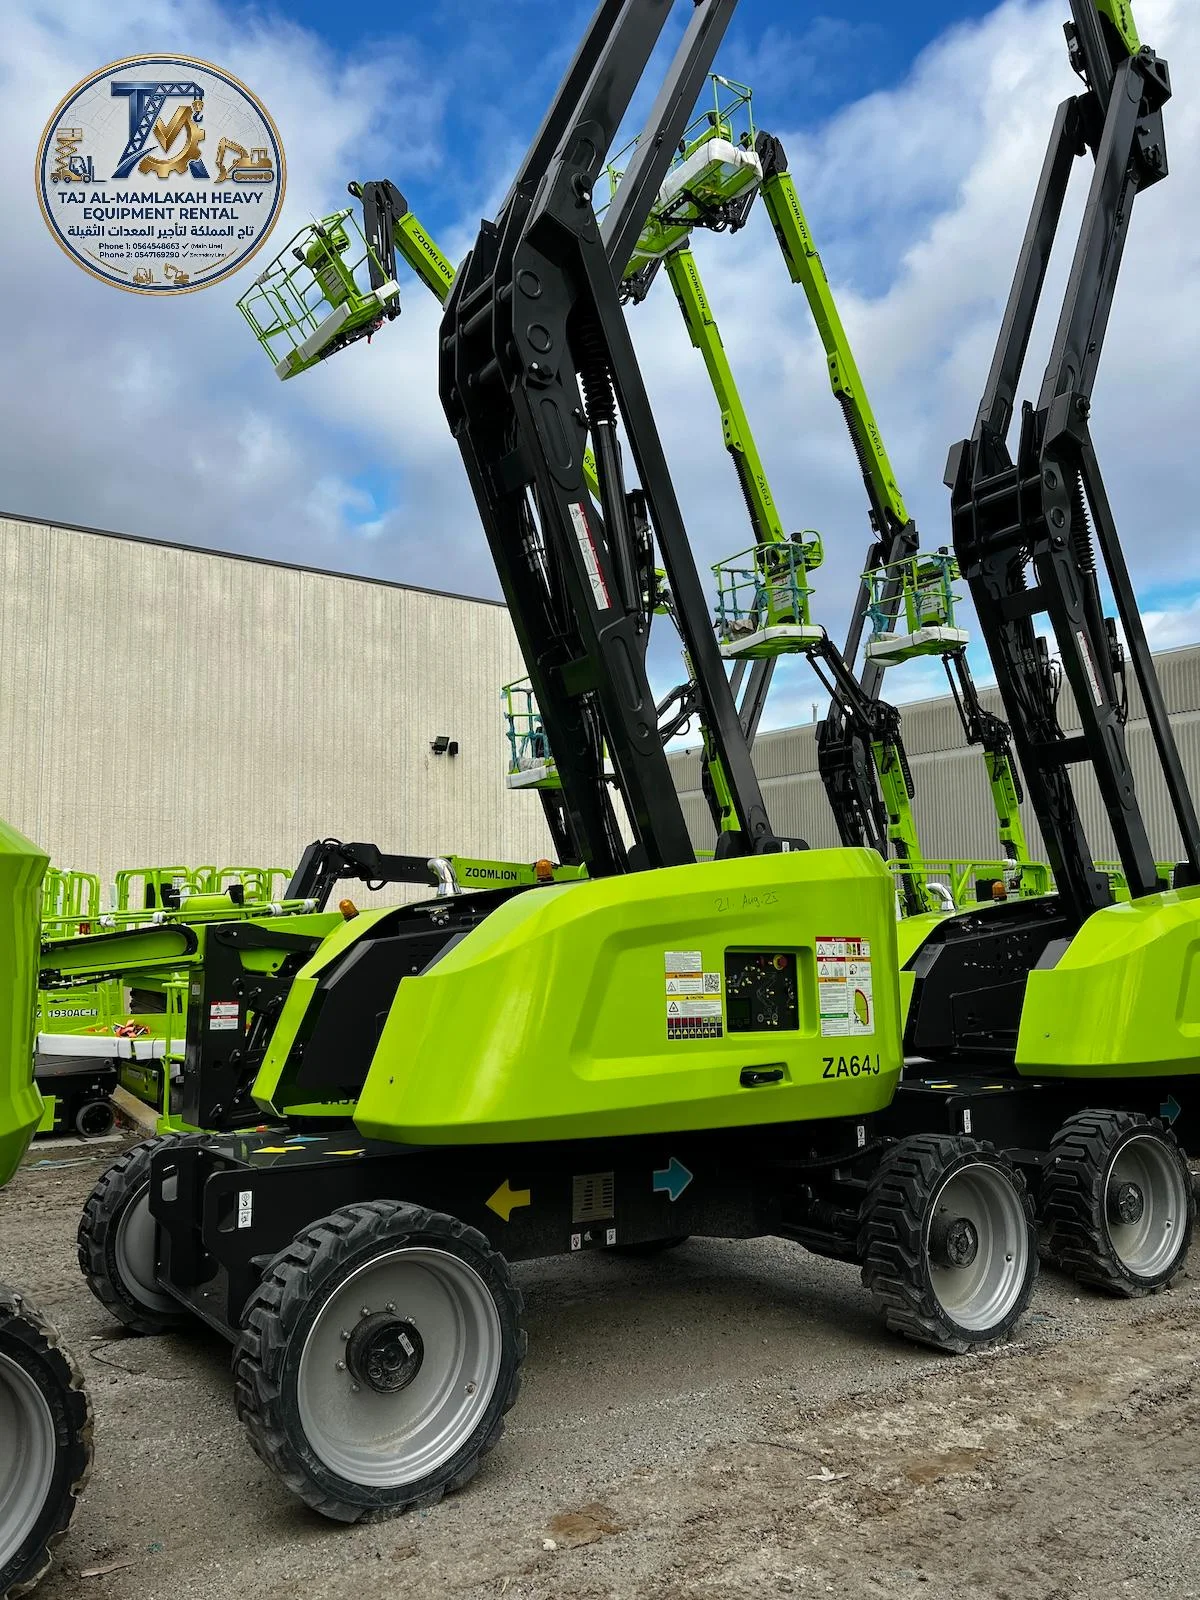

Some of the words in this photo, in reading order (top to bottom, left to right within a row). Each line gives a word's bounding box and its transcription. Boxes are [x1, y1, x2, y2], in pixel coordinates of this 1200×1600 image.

[786, 187, 808, 239] ZOOMLION
[412, 228, 453, 280] ZOOMLION
[687, 262, 706, 309] ZOOMLION
[867, 422, 884, 457] ZA64J
[756, 474, 771, 506] ZA64J
[465, 867, 517, 881] ZOOMLION
[822, 1053, 880, 1079] ZA64J
